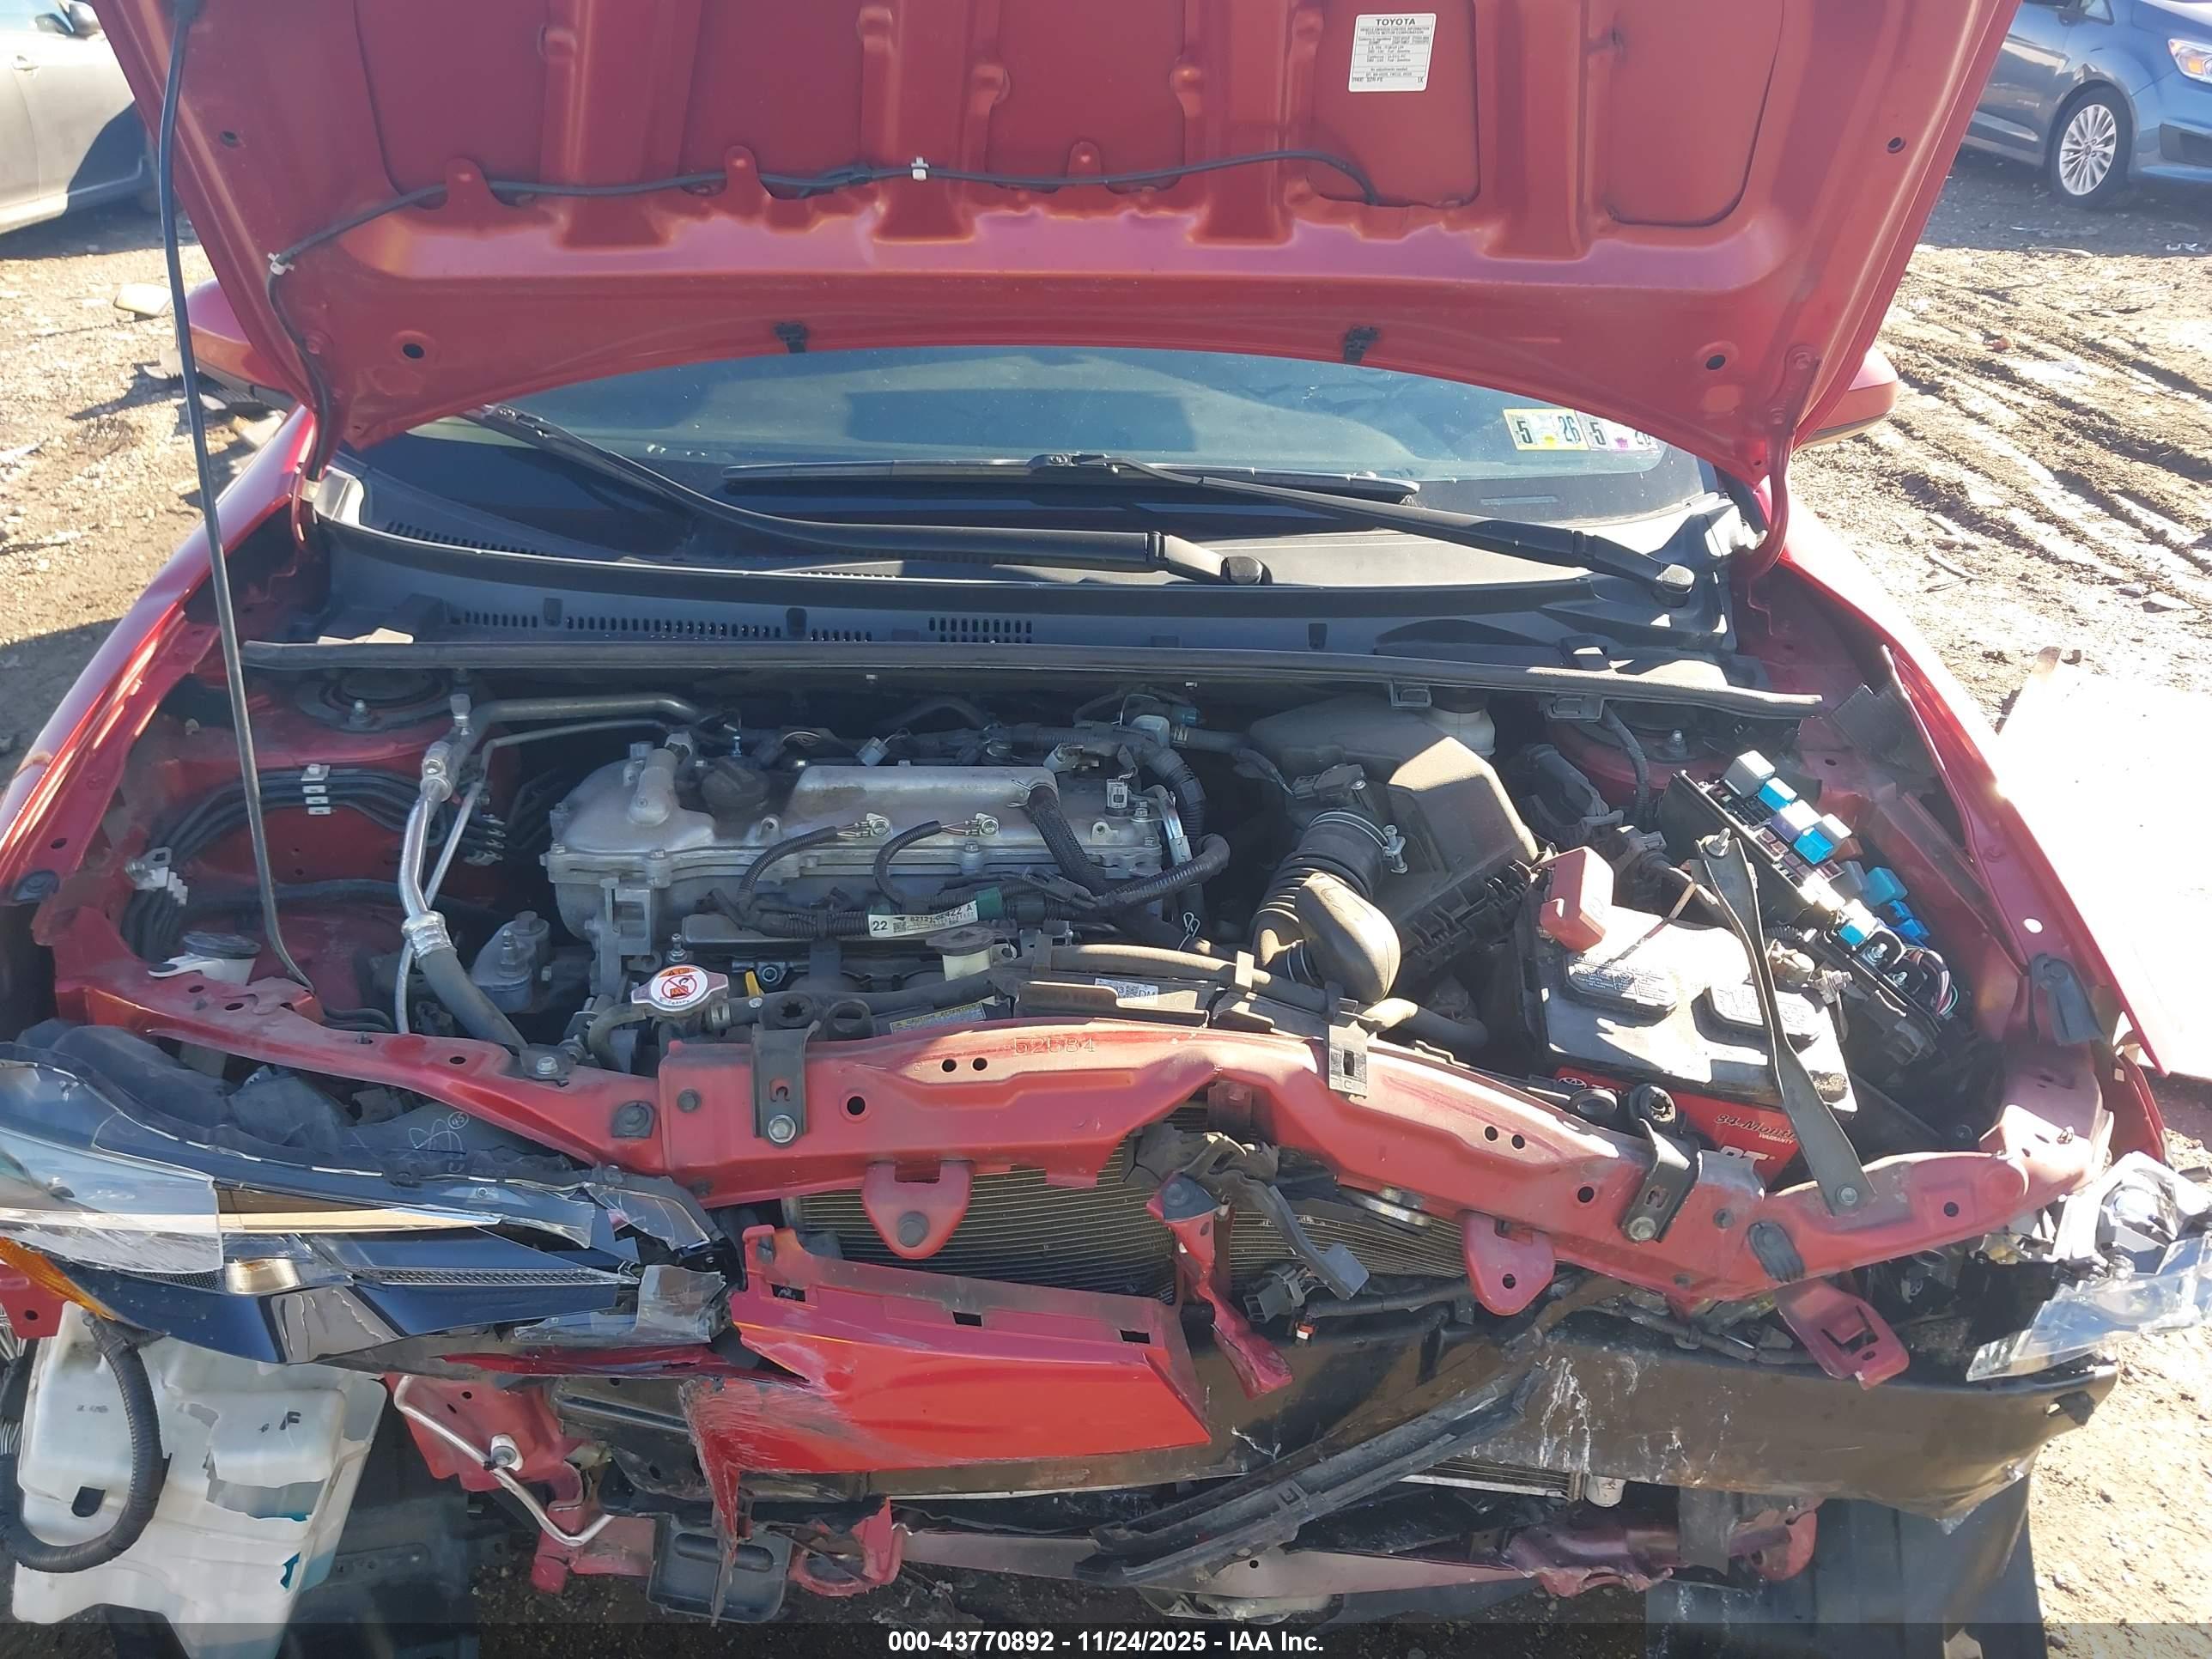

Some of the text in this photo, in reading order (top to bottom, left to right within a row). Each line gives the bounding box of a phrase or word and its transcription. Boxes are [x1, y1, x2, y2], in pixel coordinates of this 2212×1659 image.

[1516, 416, 1582, 444] 5 26
[1589, 422, 1607, 446] 5
[872, 921, 888, 932] 22
